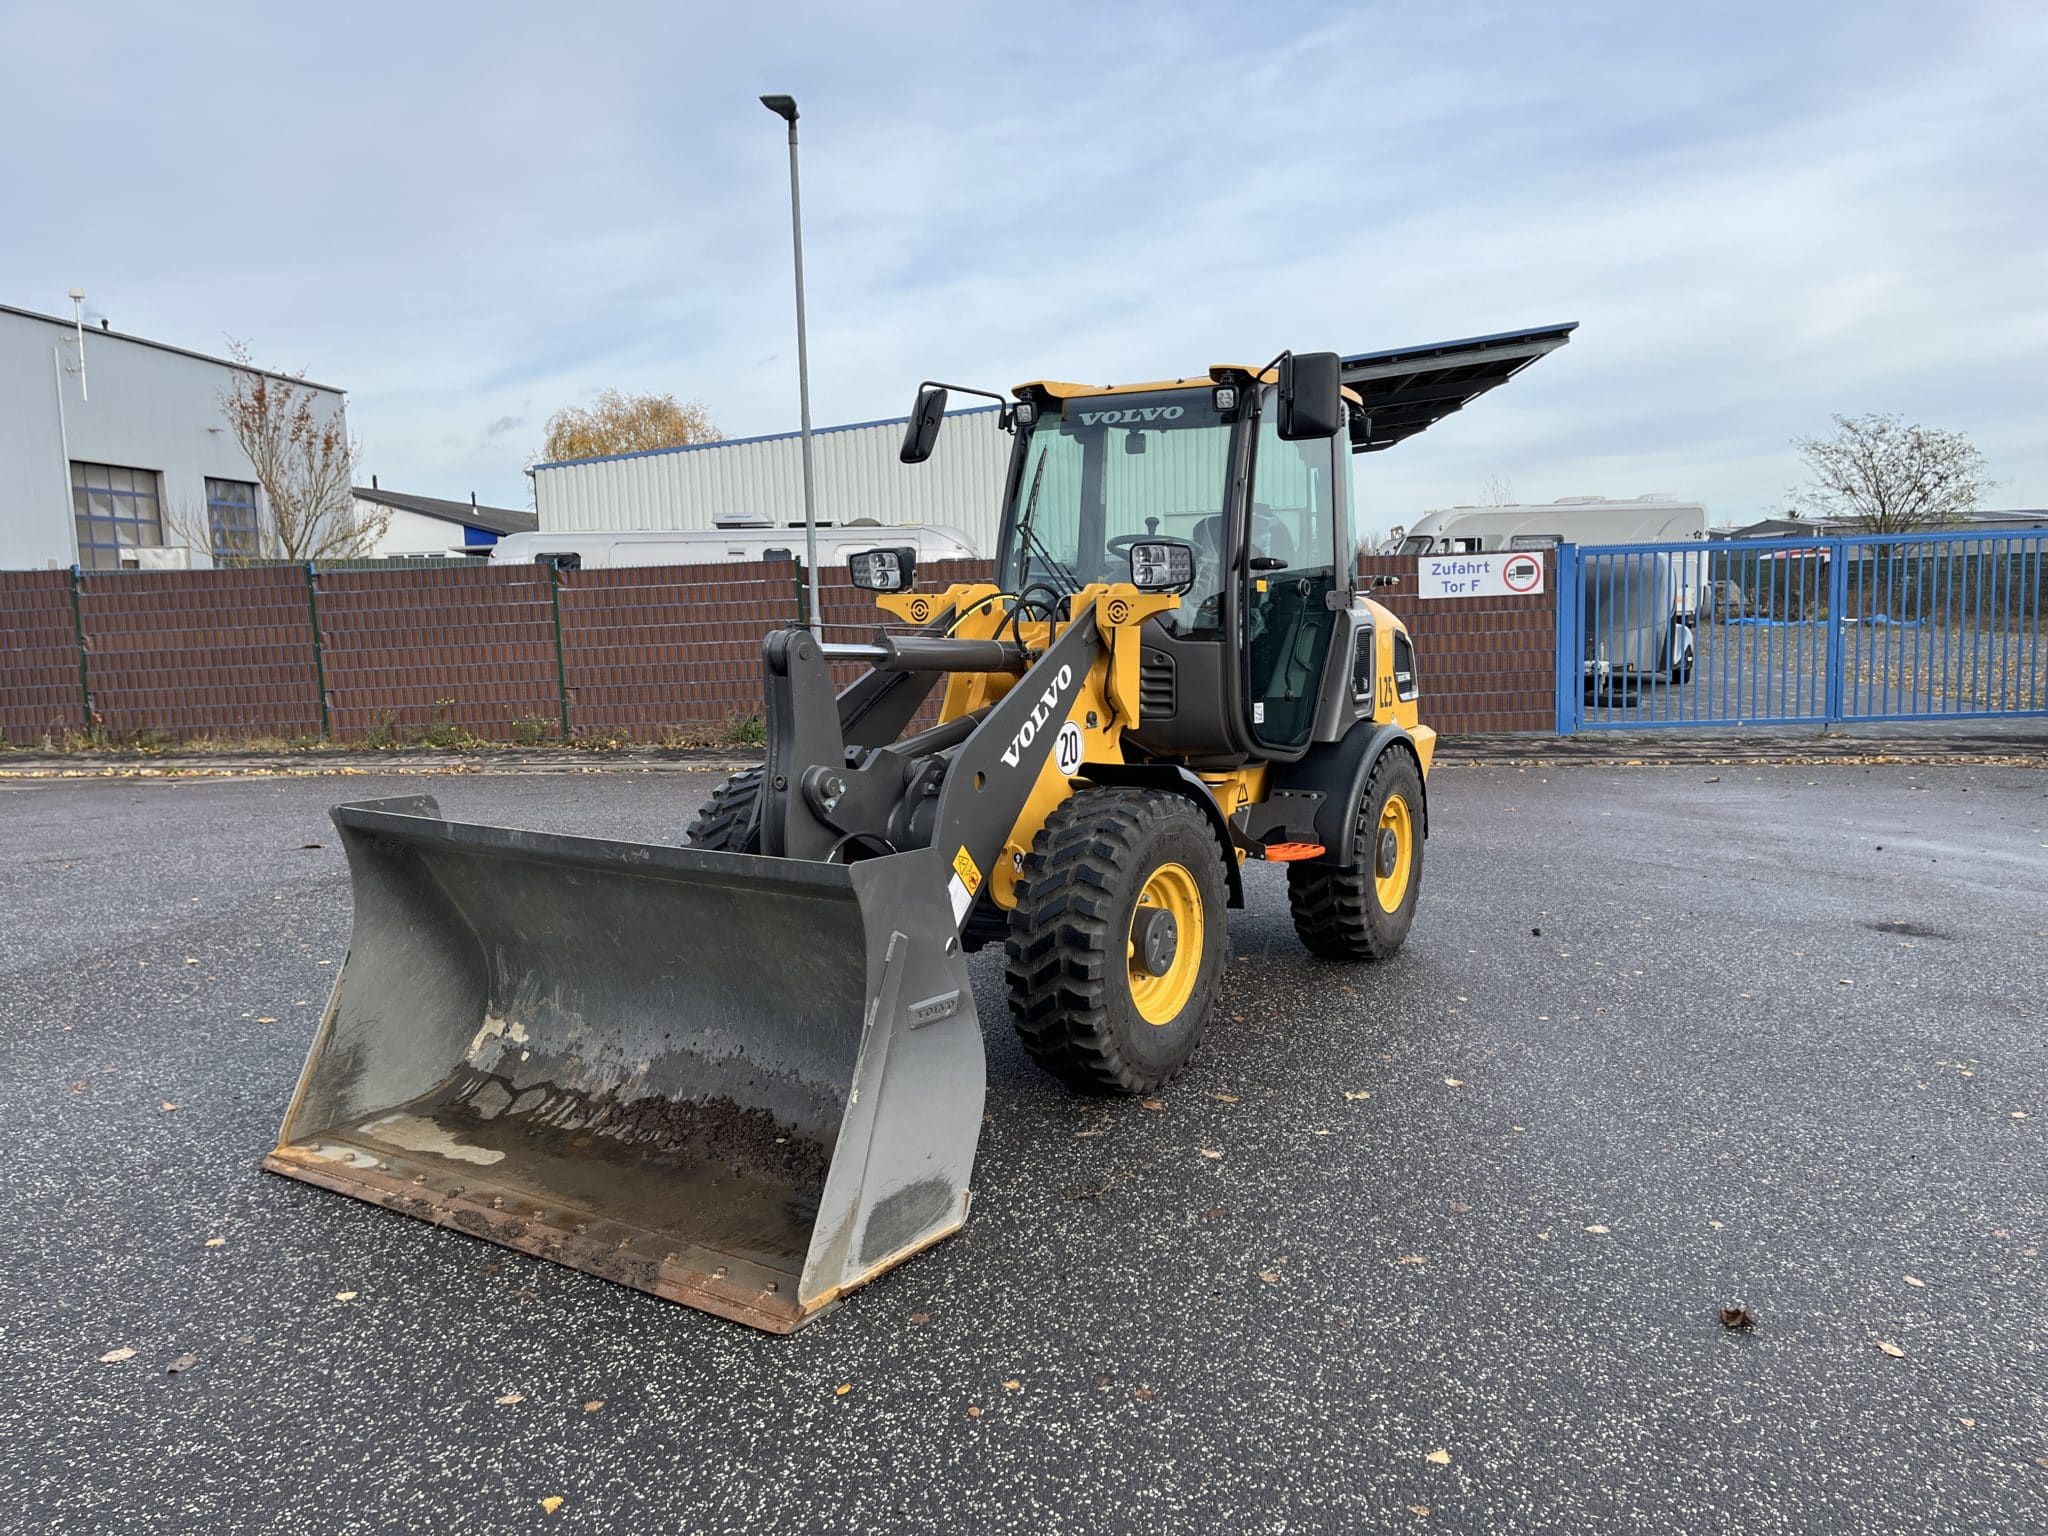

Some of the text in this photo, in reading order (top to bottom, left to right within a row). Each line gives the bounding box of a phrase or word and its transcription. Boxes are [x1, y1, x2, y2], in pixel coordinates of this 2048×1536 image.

[1079, 406, 1184, 425] VOLVO
[1431, 561, 1490, 576] Zufahrt
[1441, 579, 1481, 593] Tor F
[1000, 664, 1072, 768] VOLVO
[1060, 730, 1078, 767] 20
